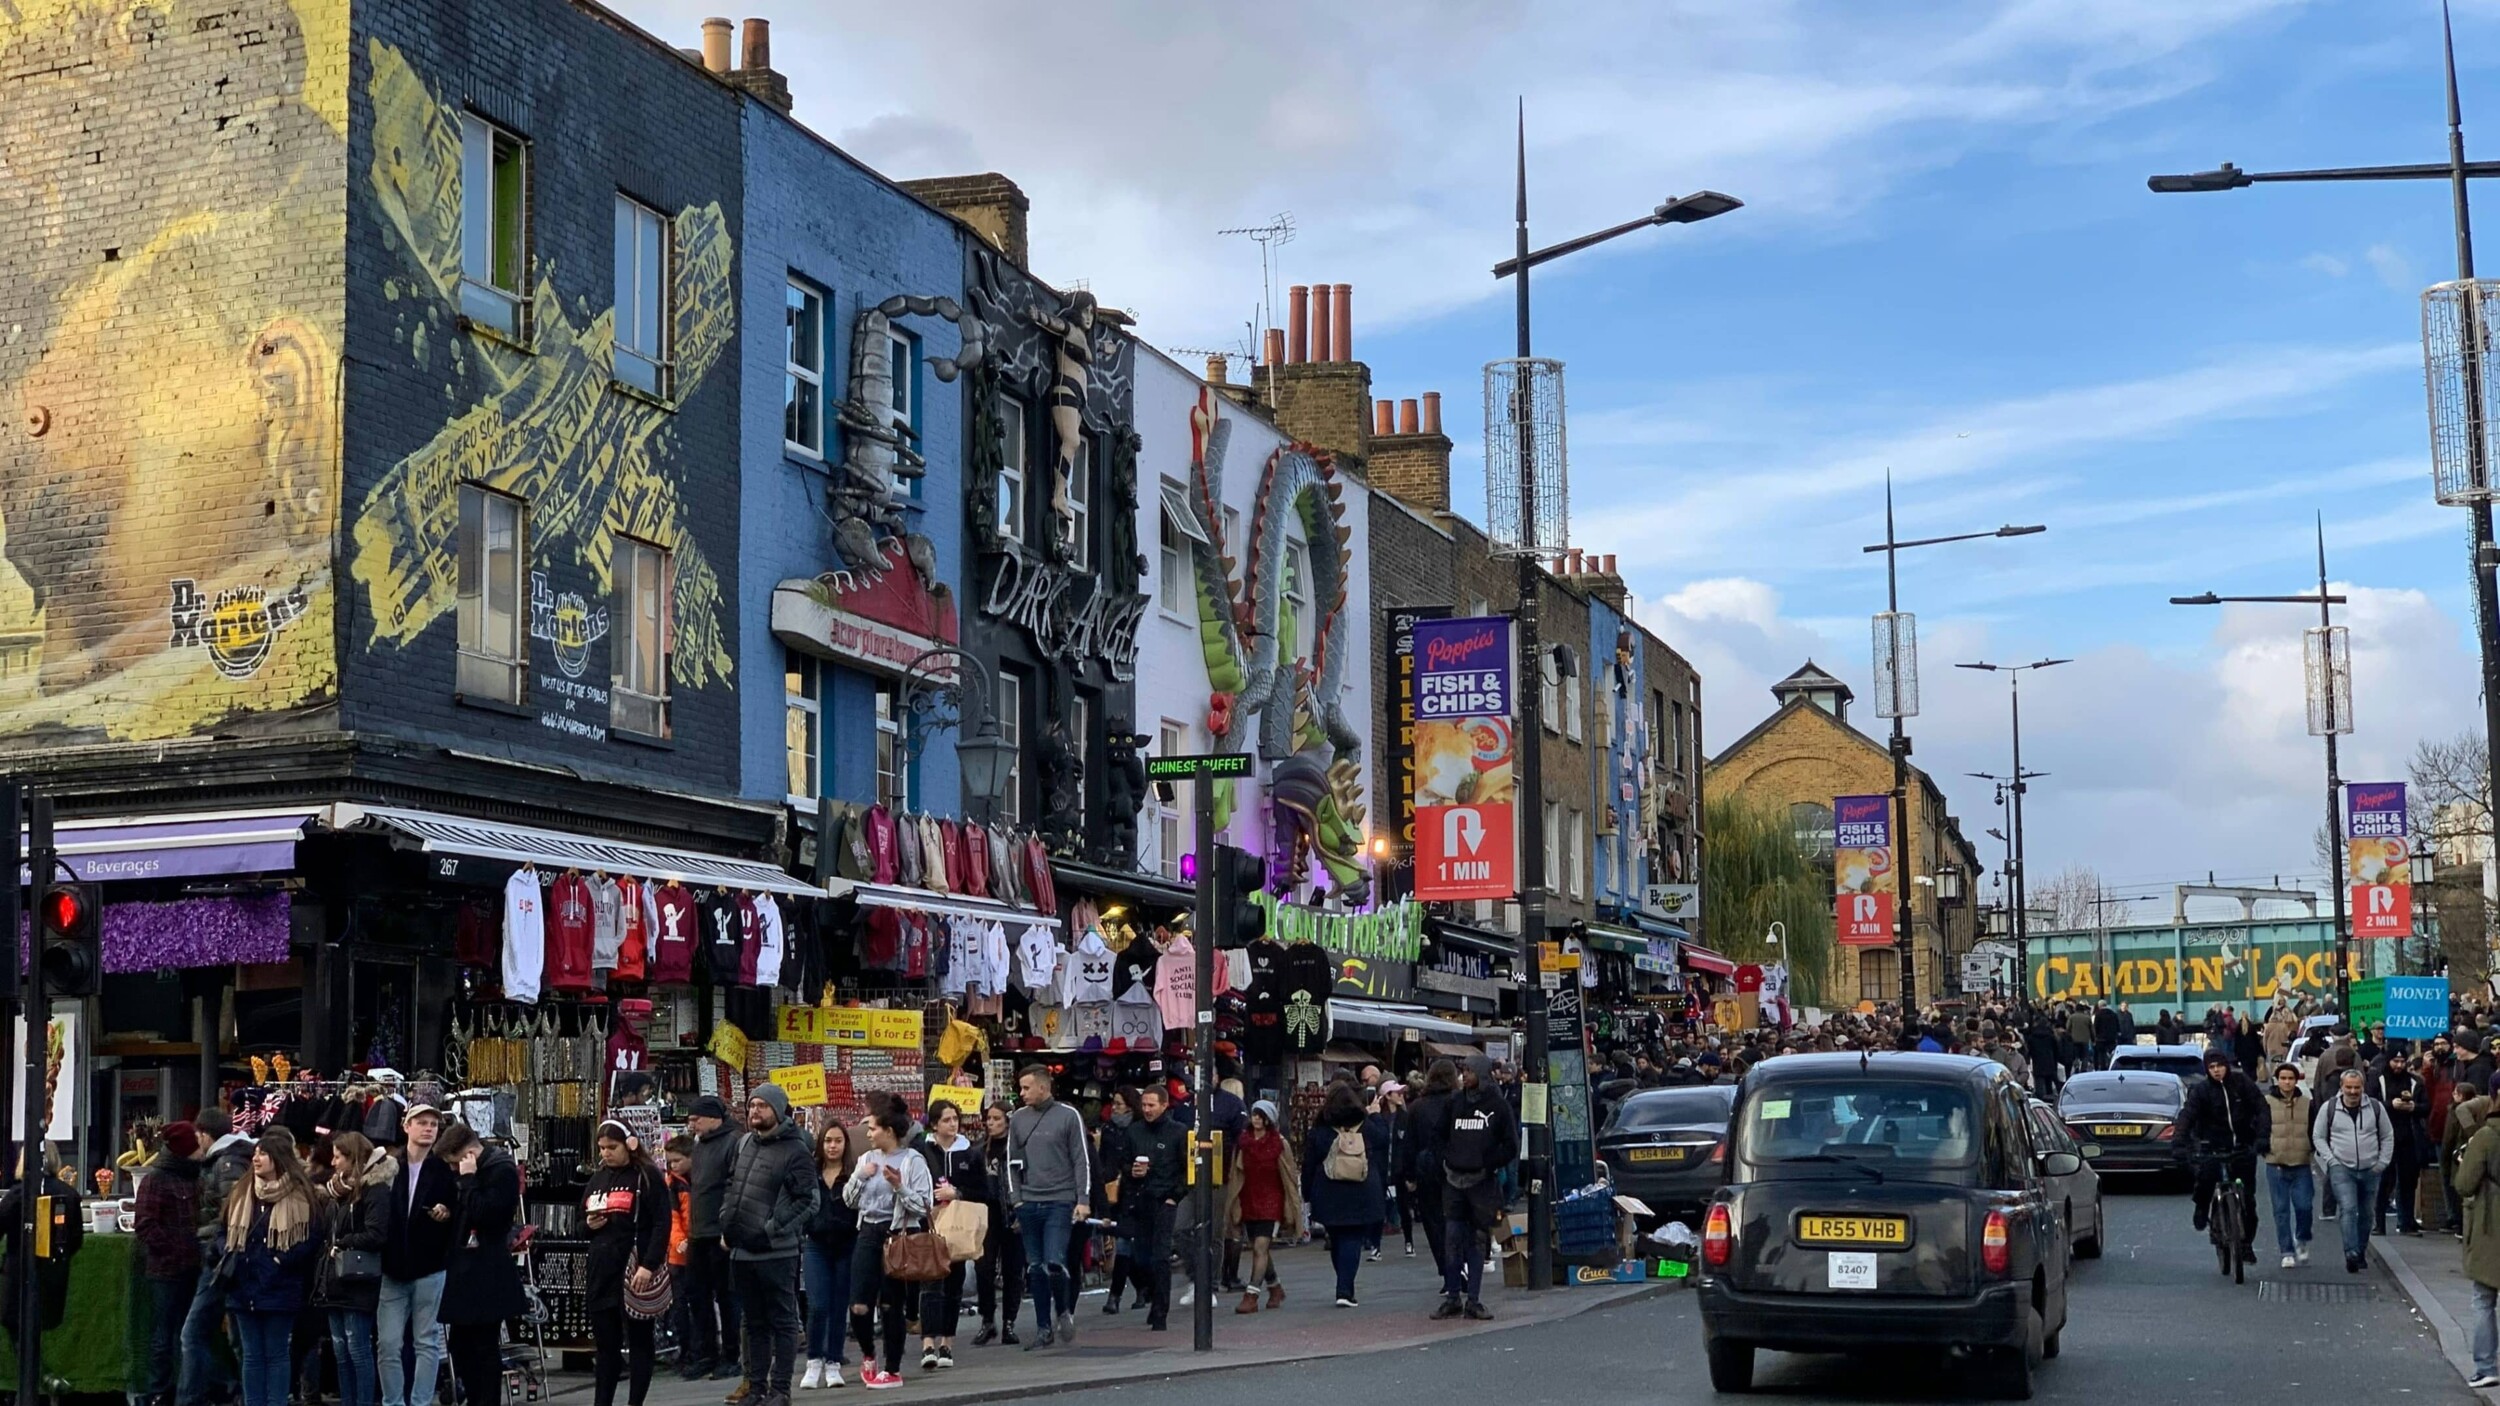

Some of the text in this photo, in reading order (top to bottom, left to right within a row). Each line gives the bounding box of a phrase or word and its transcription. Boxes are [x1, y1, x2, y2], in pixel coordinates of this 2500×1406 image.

[988, 549, 1073, 660] DARK
[169, 585, 308, 648] Martens
[531, 605, 610, 641] Martens
[1427, 628, 1494, 671] Poppies
[541, 674, 556, 690] VISIT
[556, 679, 566, 694] US
[574, 684, 586, 698] THE
[1421, 673, 1501, 694] FISH &
[566, 698, 576, 712] OR
[1421, 692, 1502, 713] CHIPS
[1149, 760, 1198, 774] CHINESE
[2356, 789, 2397, 811] Poppies
[1842, 801, 1880, 821] Poppies
[2353, 812, 2401, 824] FISH &
[1839, 824, 1885, 834] FISH &
[2353, 823, 2403, 835] CHIPS
[1840, 834, 1886, 845] CHIPS
[87, 859, 159, 875] Beverages
[440, 859, 458, 876] 267
[1438, 860, 1490, 881] 1 MIN
[1650, 893, 1693, 906] Martens
[2366, 915, 2398, 927] 2 MIN
[1283, 904, 1315, 941] CAN
[1322, 913, 1349, 949] EAT
[1352, 914, 1379, 953] FOR
[1851, 922, 1880, 934] 2 MIN
[1174, 966, 1192, 974] ANTI
[1170, 974, 1194, 983] SOCIAL
[1170, 983, 1195, 991] SOCIAL
[1765, 982, 1776, 991] 33
[2390, 987, 2444, 1000] MONEY
[785, 1008, 814, 1033] £1
[840, 1012, 863, 1020] accept
[2386, 1015, 2448, 1028] CHANGE
[874, 1030, 917, 1040] 6 for £5
[786, 1079, 820, 1092] for £1
[1455, 1118, 1484, 1130] PUMA
[1809, 1221, 1896, 1238] LR55 VHB
[1838, 1266, 1868, 1275] 82407
